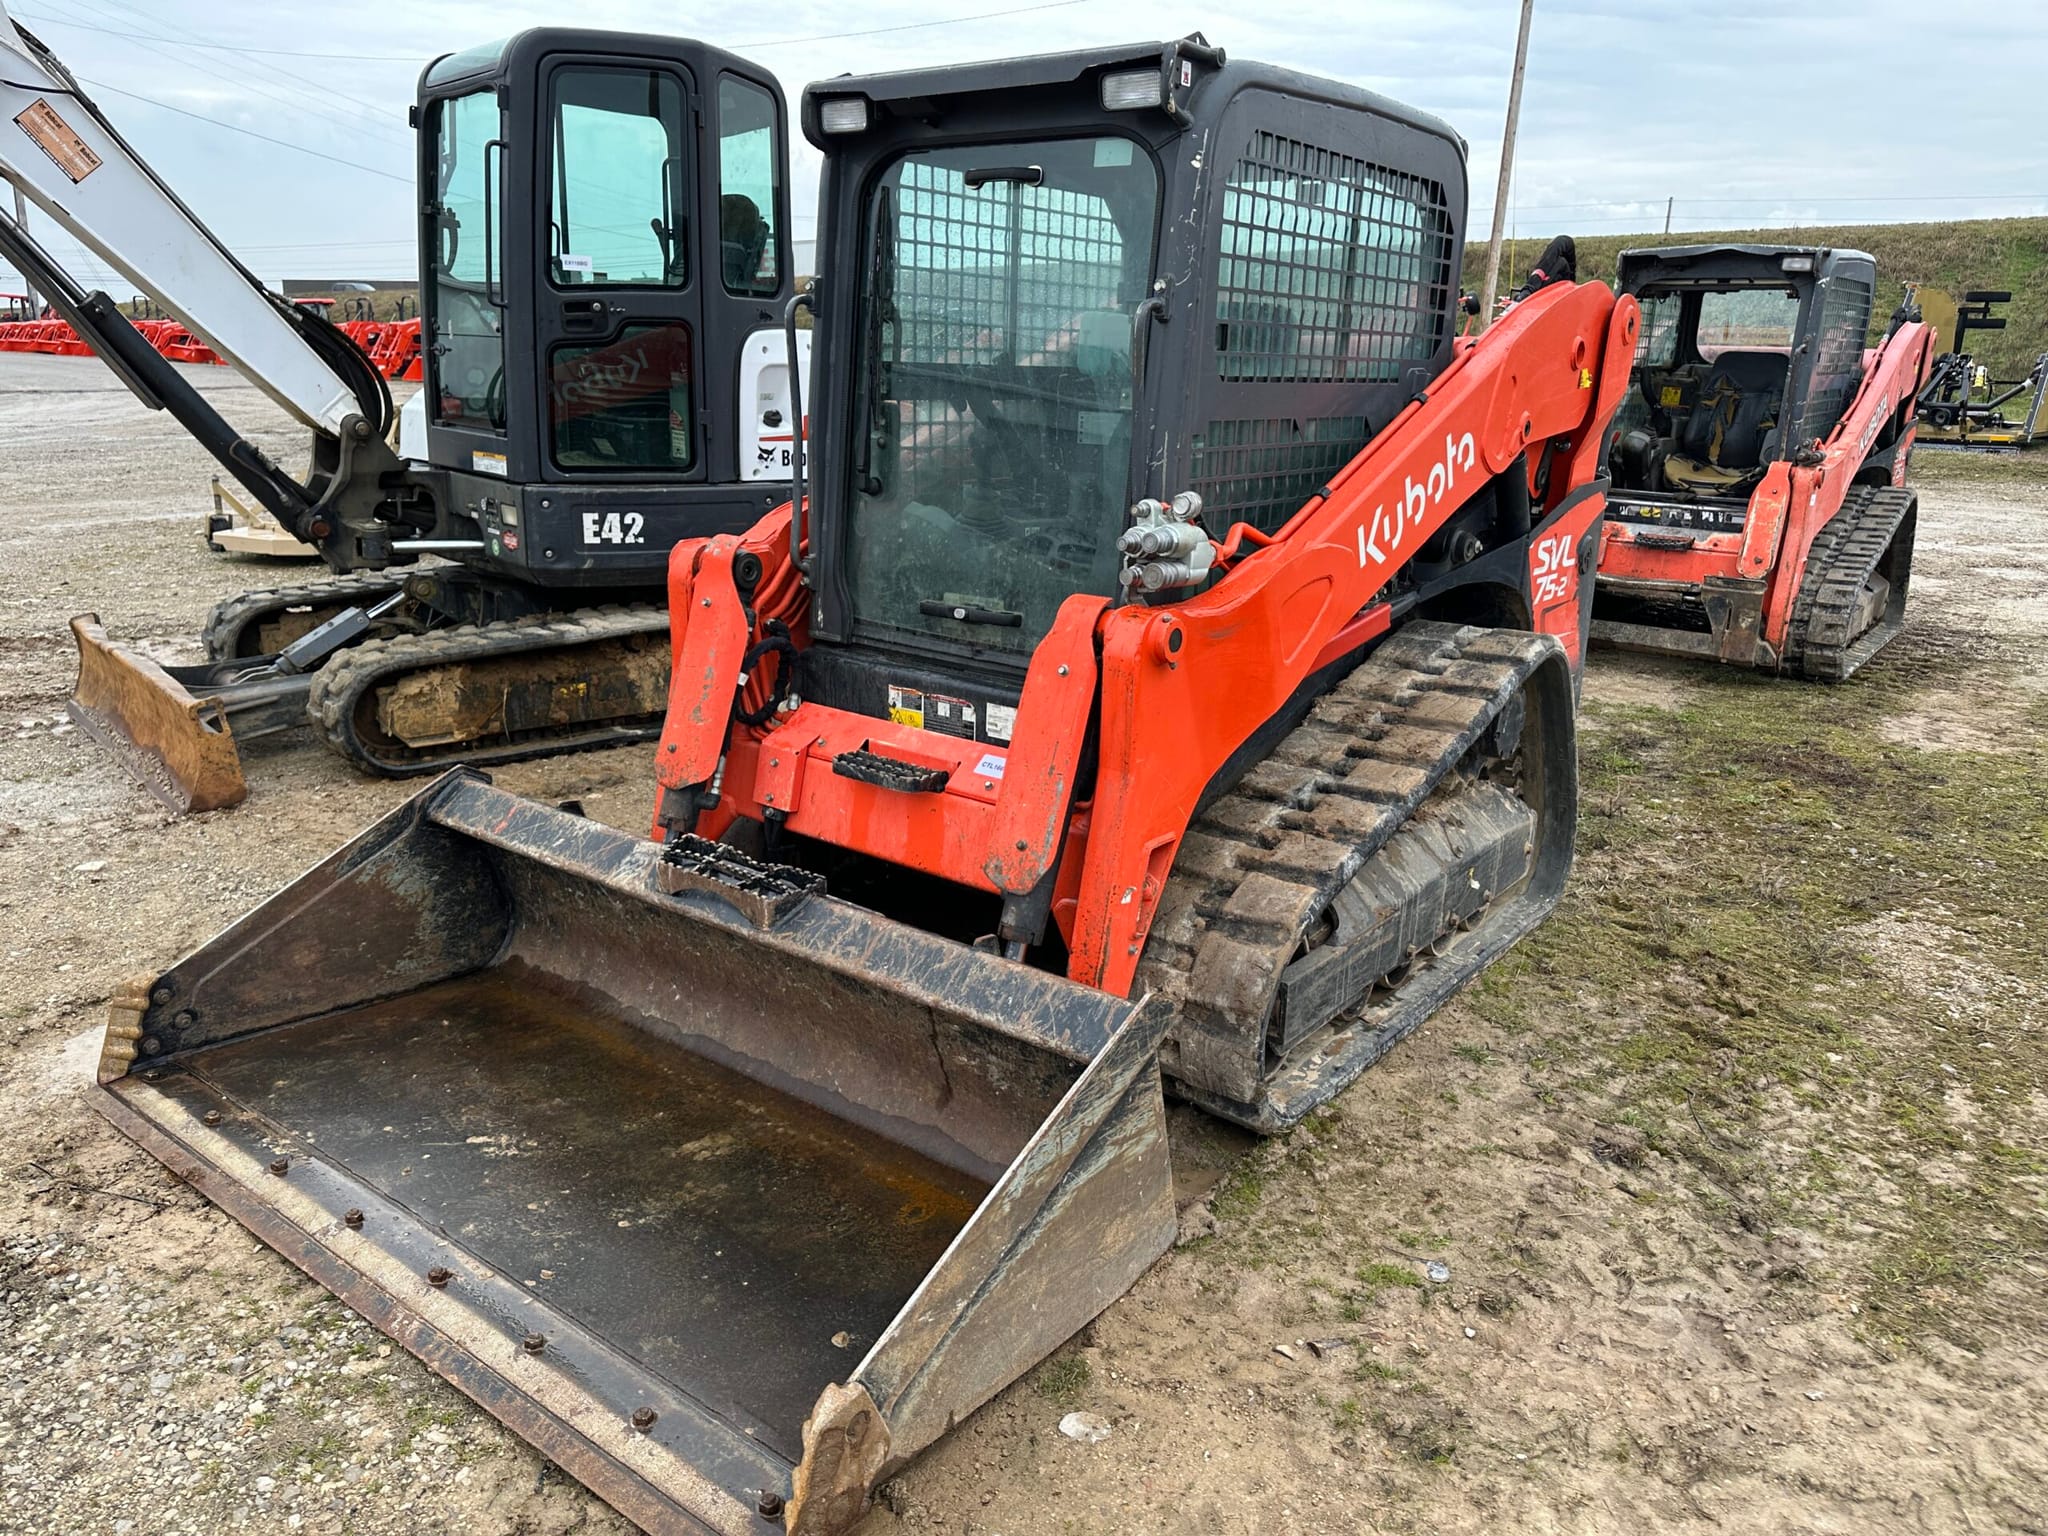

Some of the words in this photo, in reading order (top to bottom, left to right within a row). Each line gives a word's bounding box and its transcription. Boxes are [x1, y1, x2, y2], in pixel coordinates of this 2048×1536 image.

[1357, 432, 1475, 569] Kubota
[582, 512, 645, 544] E42
[1533, 534, 1576, 576] SVL
[1533, 573, 1568, 606] 75-2
